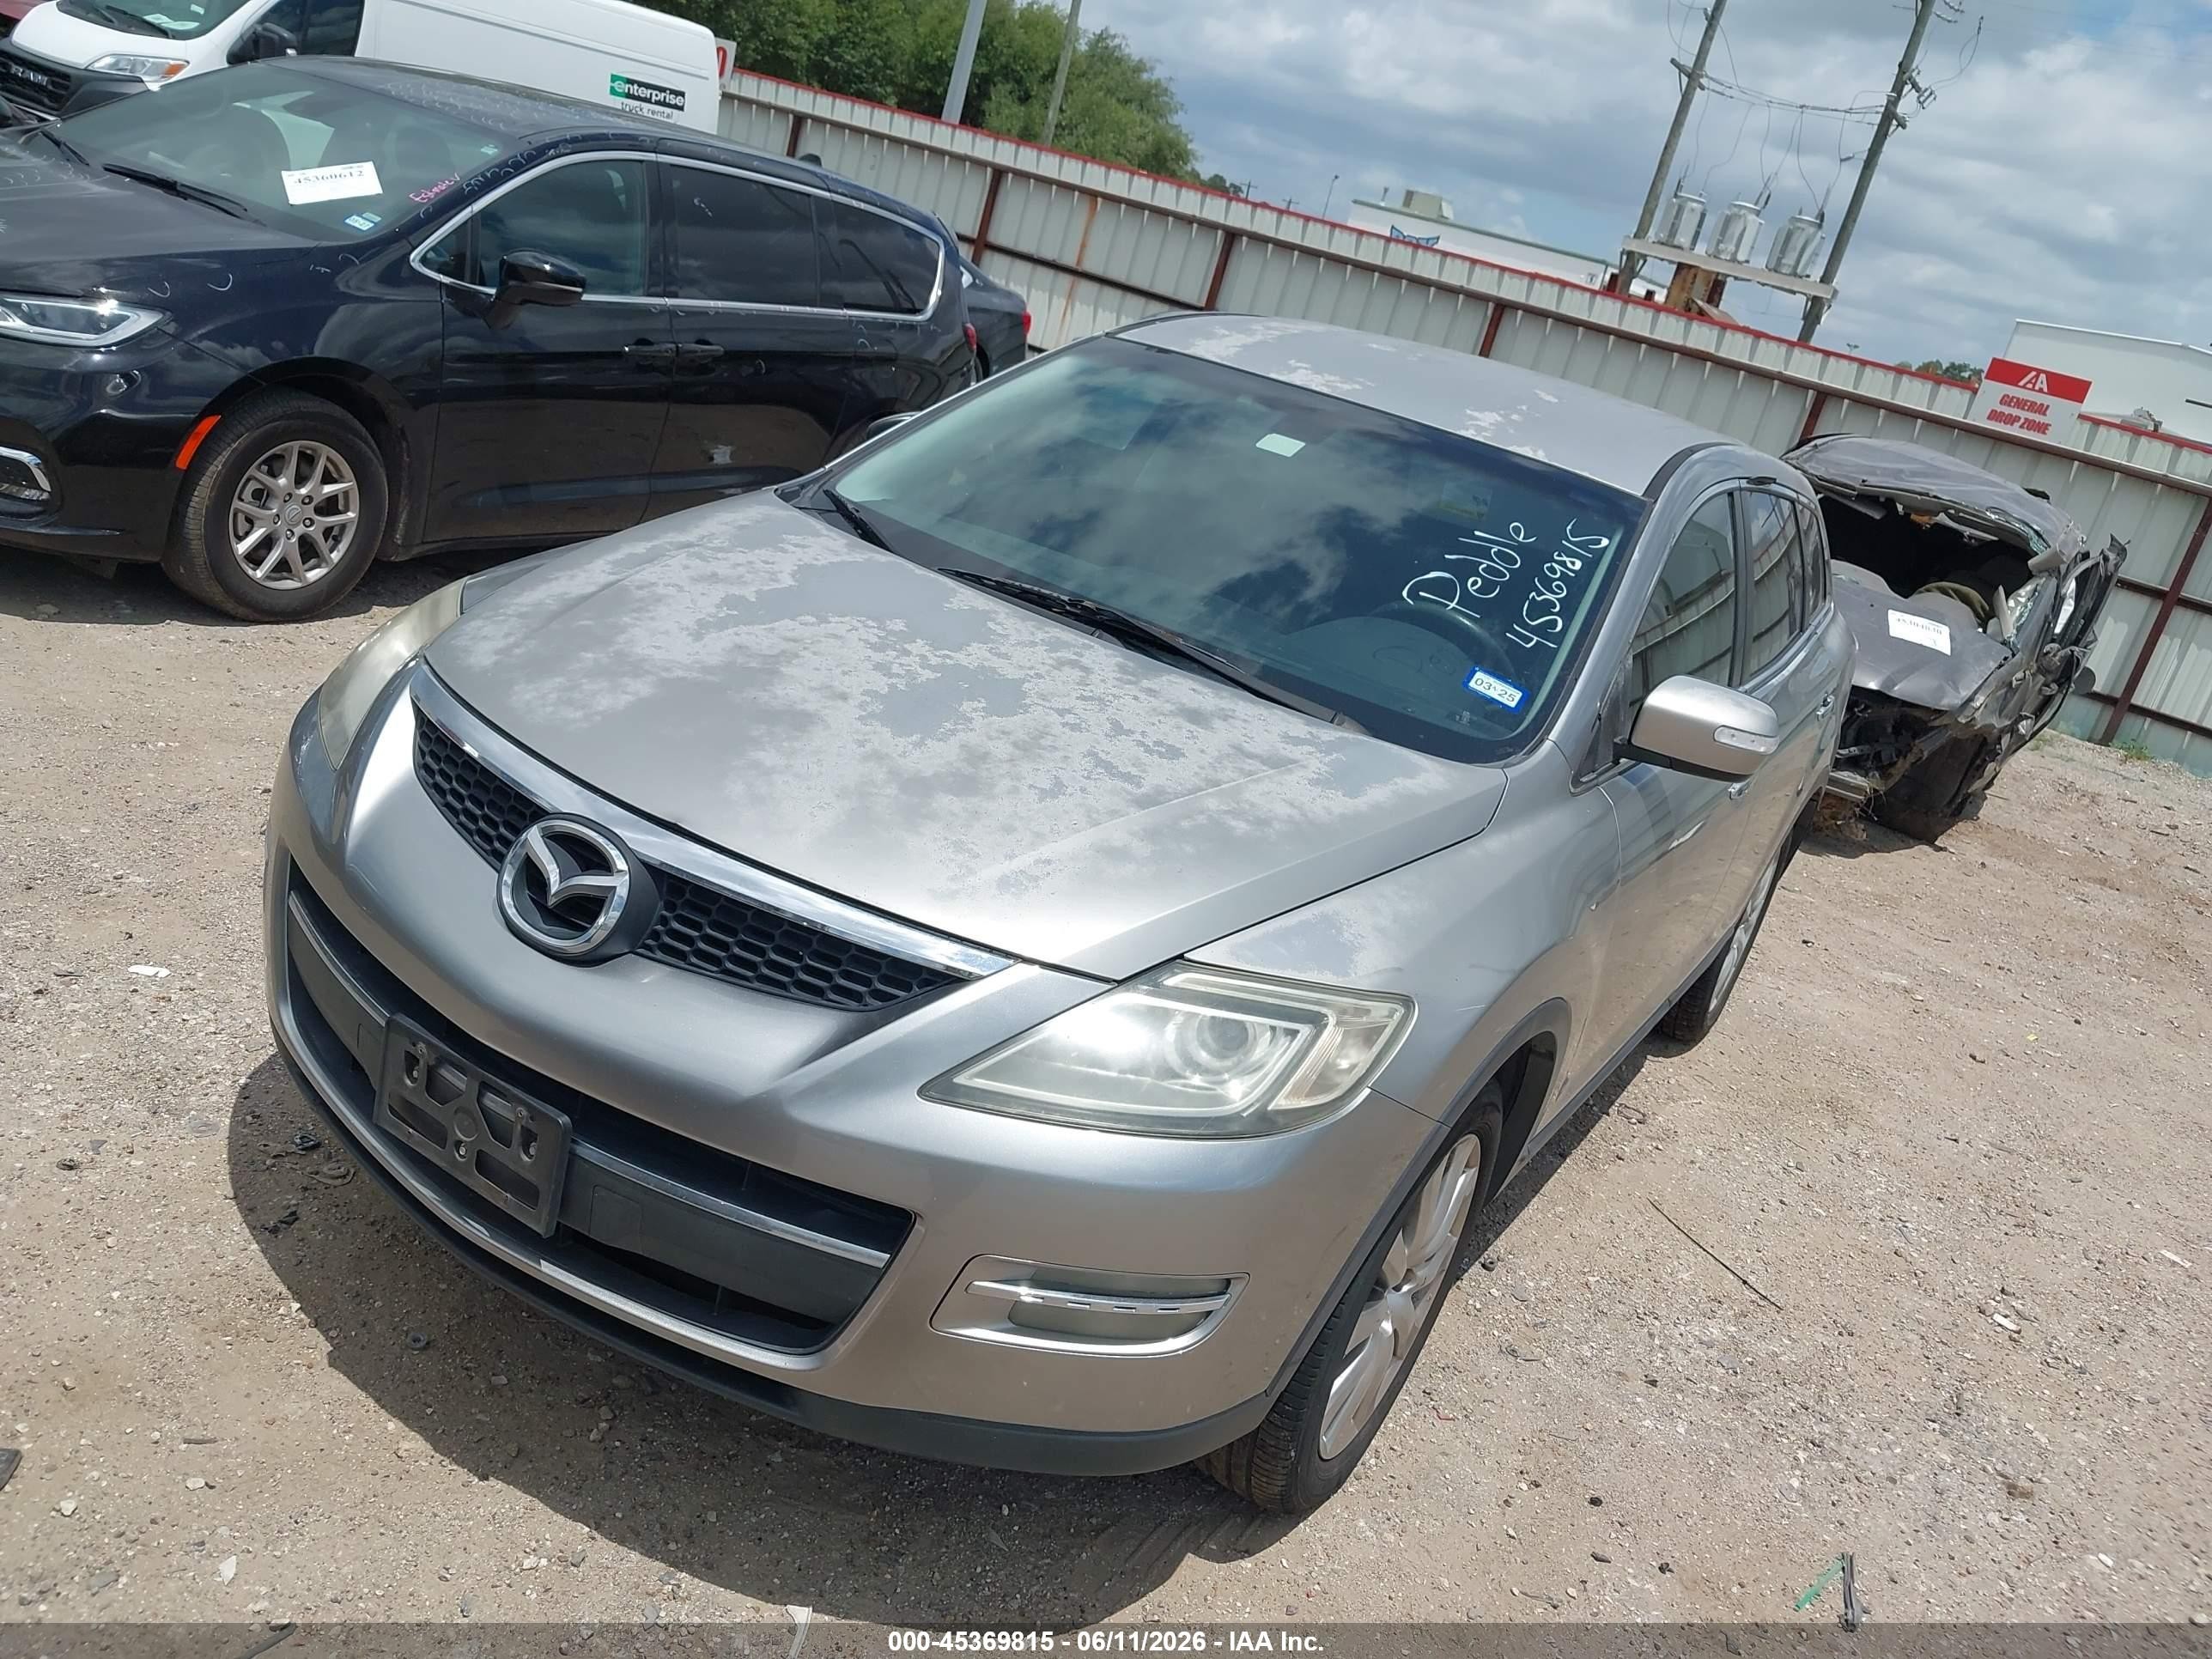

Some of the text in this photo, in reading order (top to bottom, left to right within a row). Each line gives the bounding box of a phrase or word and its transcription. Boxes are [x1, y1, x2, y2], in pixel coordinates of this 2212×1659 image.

[611, 80, 685, 106] enterprise
[621, 101, 674, 119] truck rental
[1999, 393, 2051, 416] GENERAL
[1986, 408, 2052, 435] DROP ZONE
[1401, 521, 1538, 618] Peddle
[1505, 518, 1610, 648] 45369815
